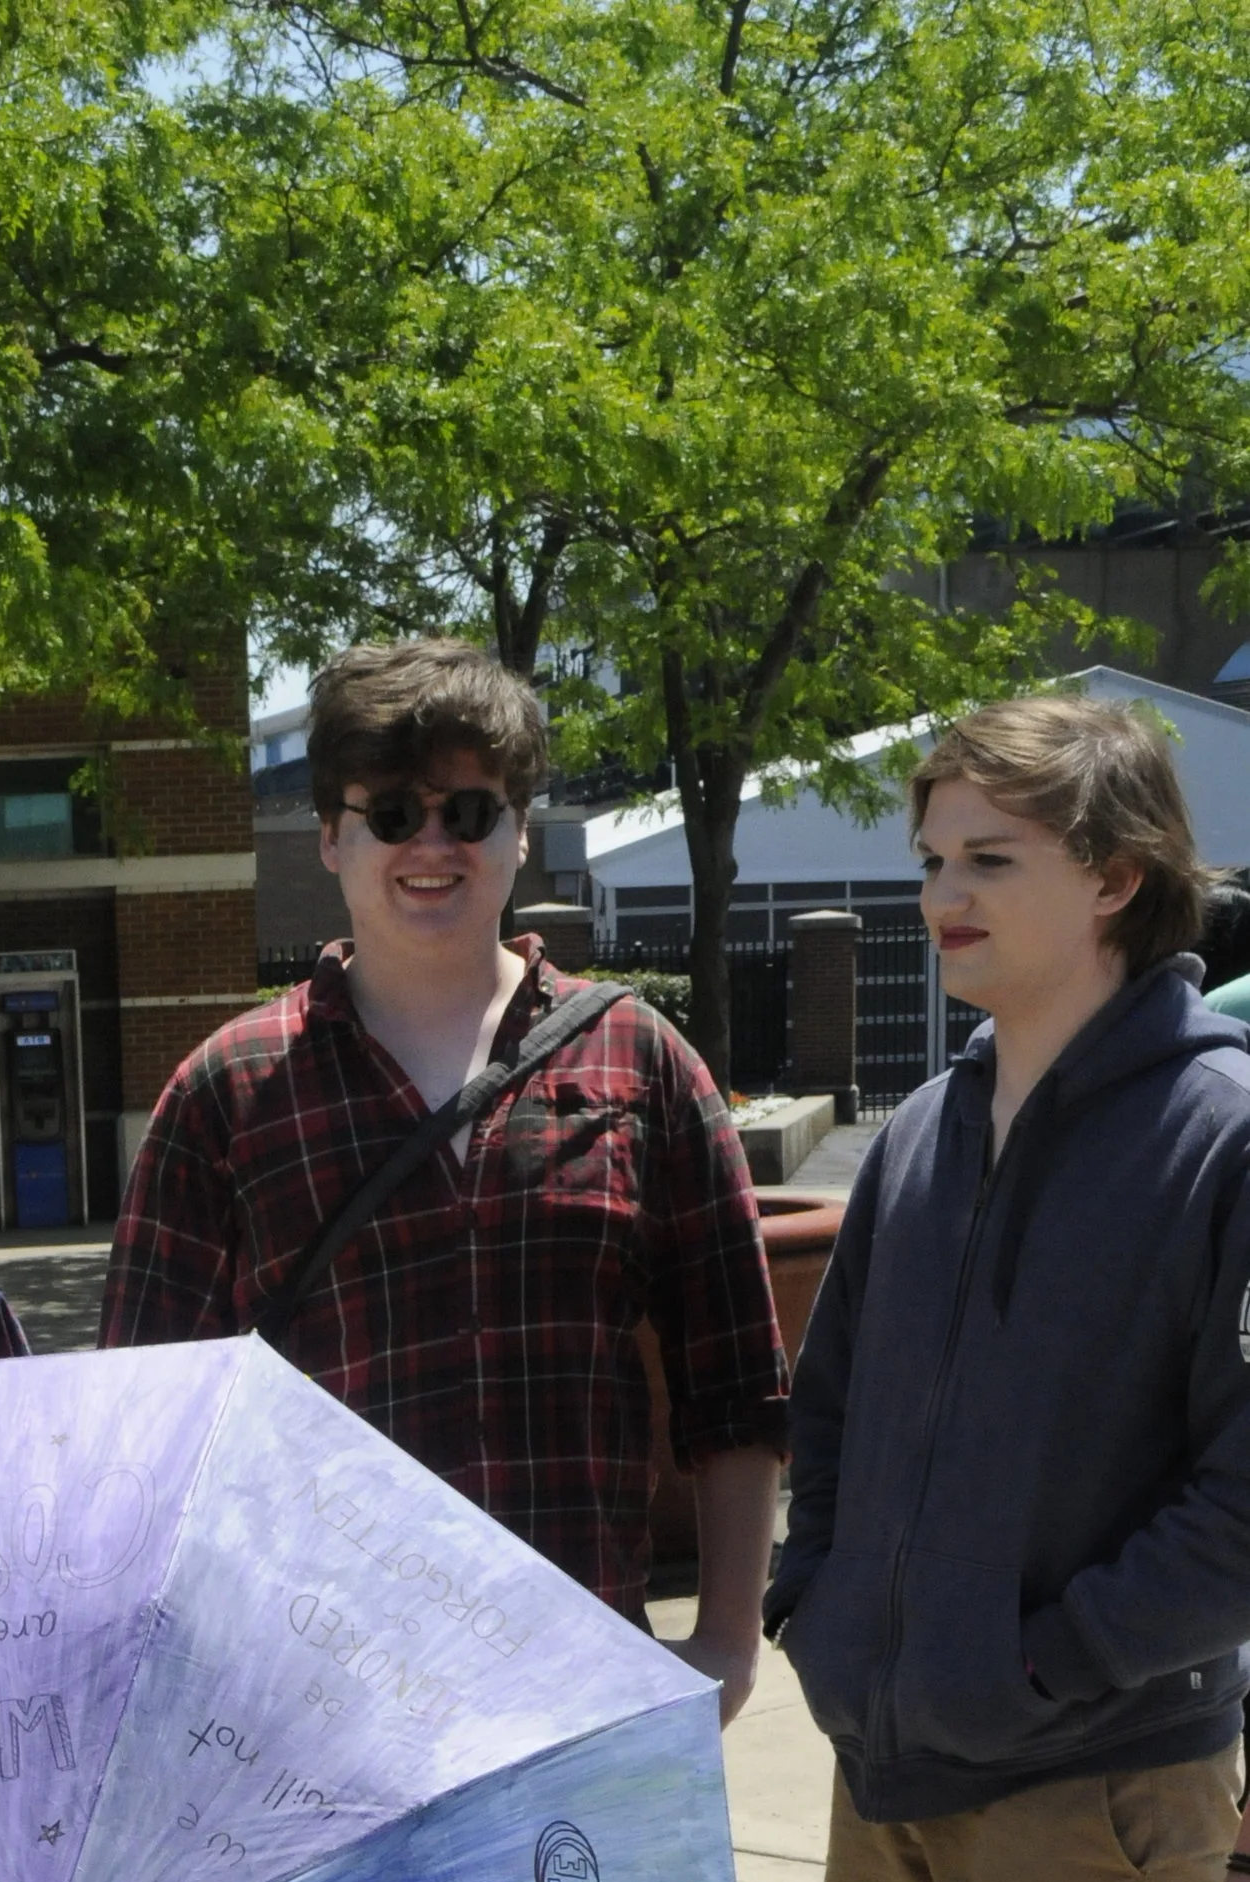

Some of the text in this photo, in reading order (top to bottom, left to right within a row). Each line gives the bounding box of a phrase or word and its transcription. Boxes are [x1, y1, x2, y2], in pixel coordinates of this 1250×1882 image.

[293, 1477, 533, 1658] FORGOTTEN
[382, 1612, 422, 1635] or
[288, 1594, 461, 1728] IGNORED
[304, 1681, 343, 1730] be
[188, 1718, 260, 1767] not
